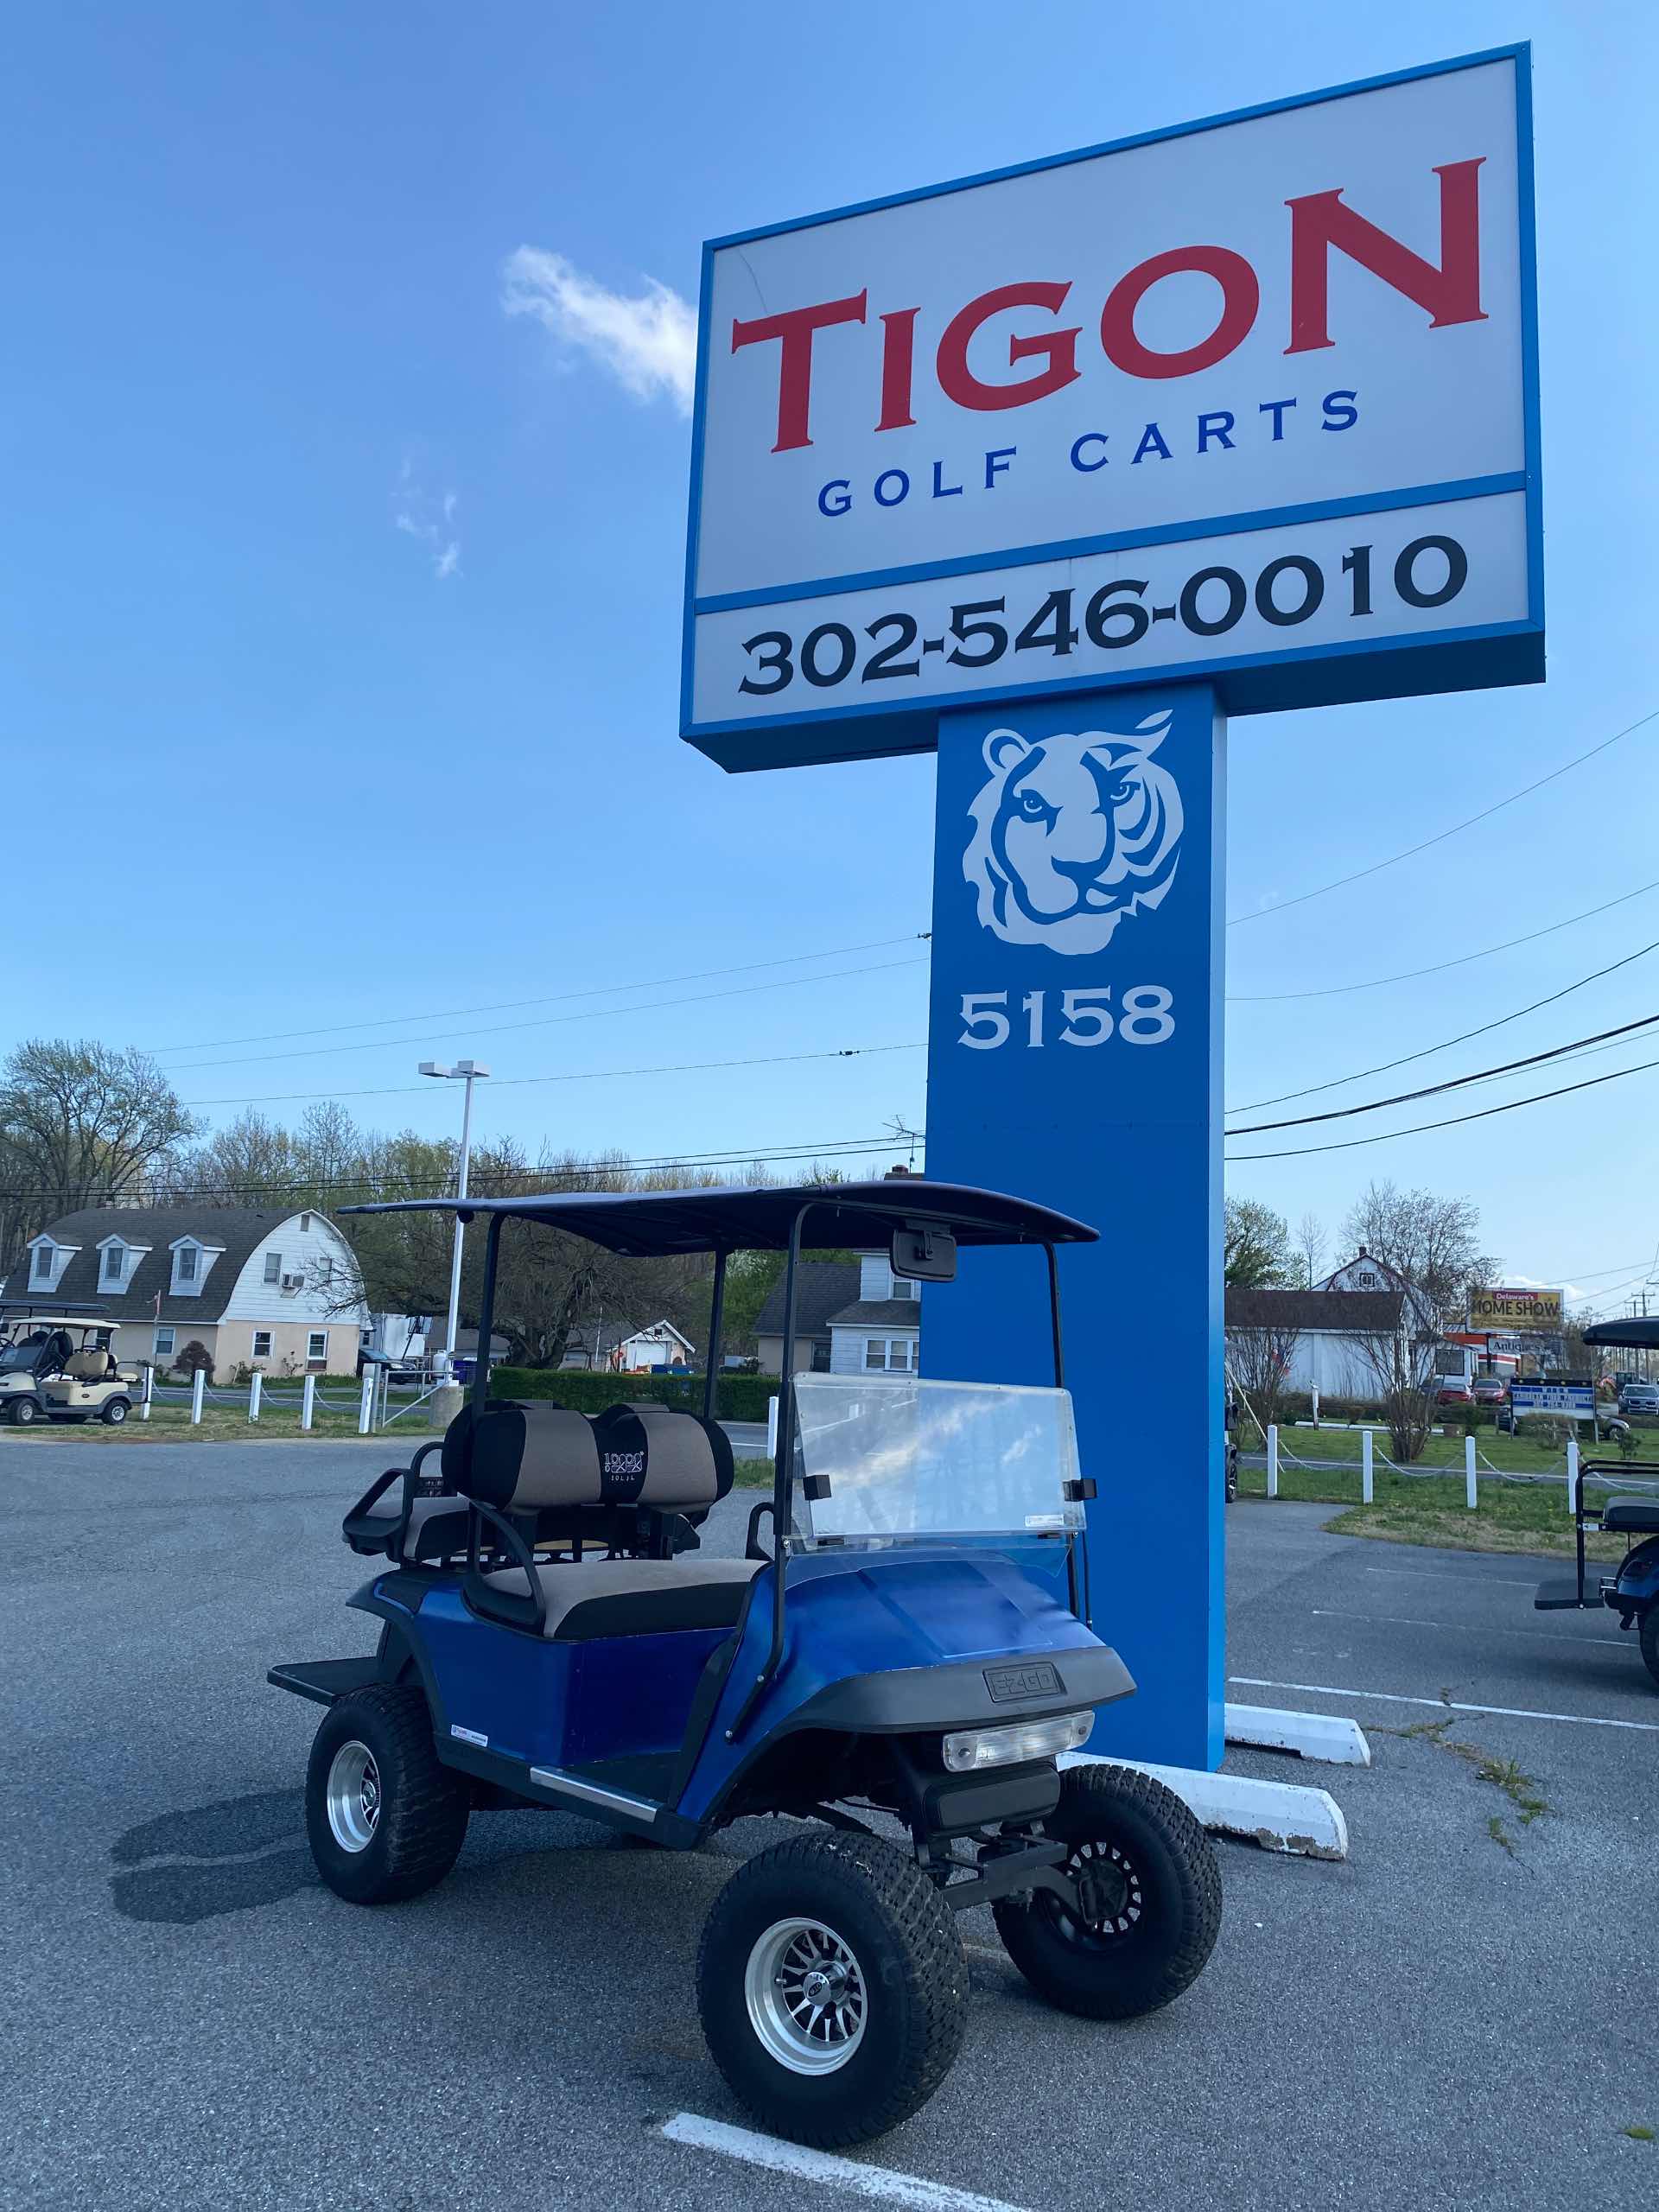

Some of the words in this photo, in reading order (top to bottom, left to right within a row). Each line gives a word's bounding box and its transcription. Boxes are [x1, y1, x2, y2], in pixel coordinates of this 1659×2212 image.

[731, 156, 1489, 453] TIGON
[817, 446, 1016, 518] GOLF
[1070, 389, 1359, 473] CARTS
[737, 534, 1468, 695] 302-546-0010
[957, 984, 1176, 1050] 5158
[1516, 1302, 1559, 1315] SHOW
